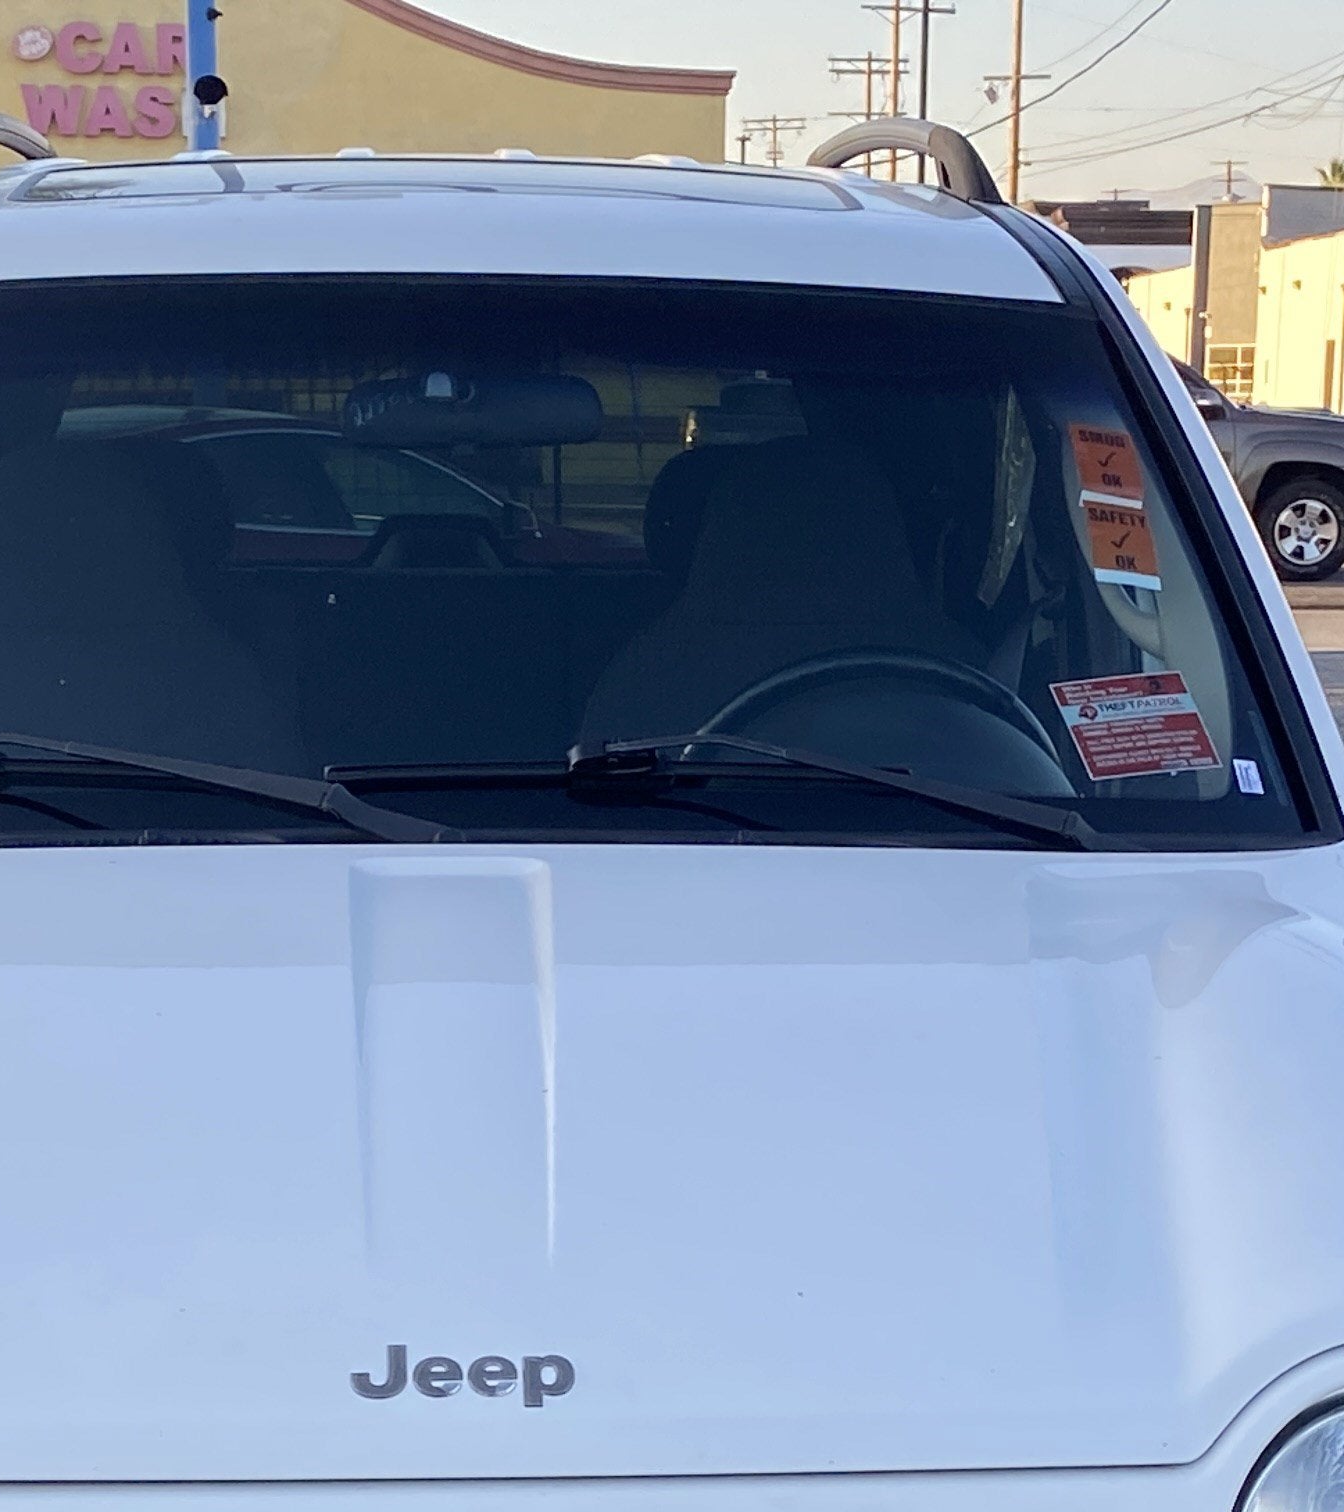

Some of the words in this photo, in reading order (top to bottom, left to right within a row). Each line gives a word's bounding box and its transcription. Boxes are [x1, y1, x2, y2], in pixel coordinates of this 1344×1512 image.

[56, 20, 186, 75] CAR
[20, 83, 177, 138] WAS
[1101, 473, 1123, 488] OK
[1088, 508, 1146, 527] SAFETY
[1115, 555, 1137, 569] OK
[350, 1344, 575, 1407] Jeep
